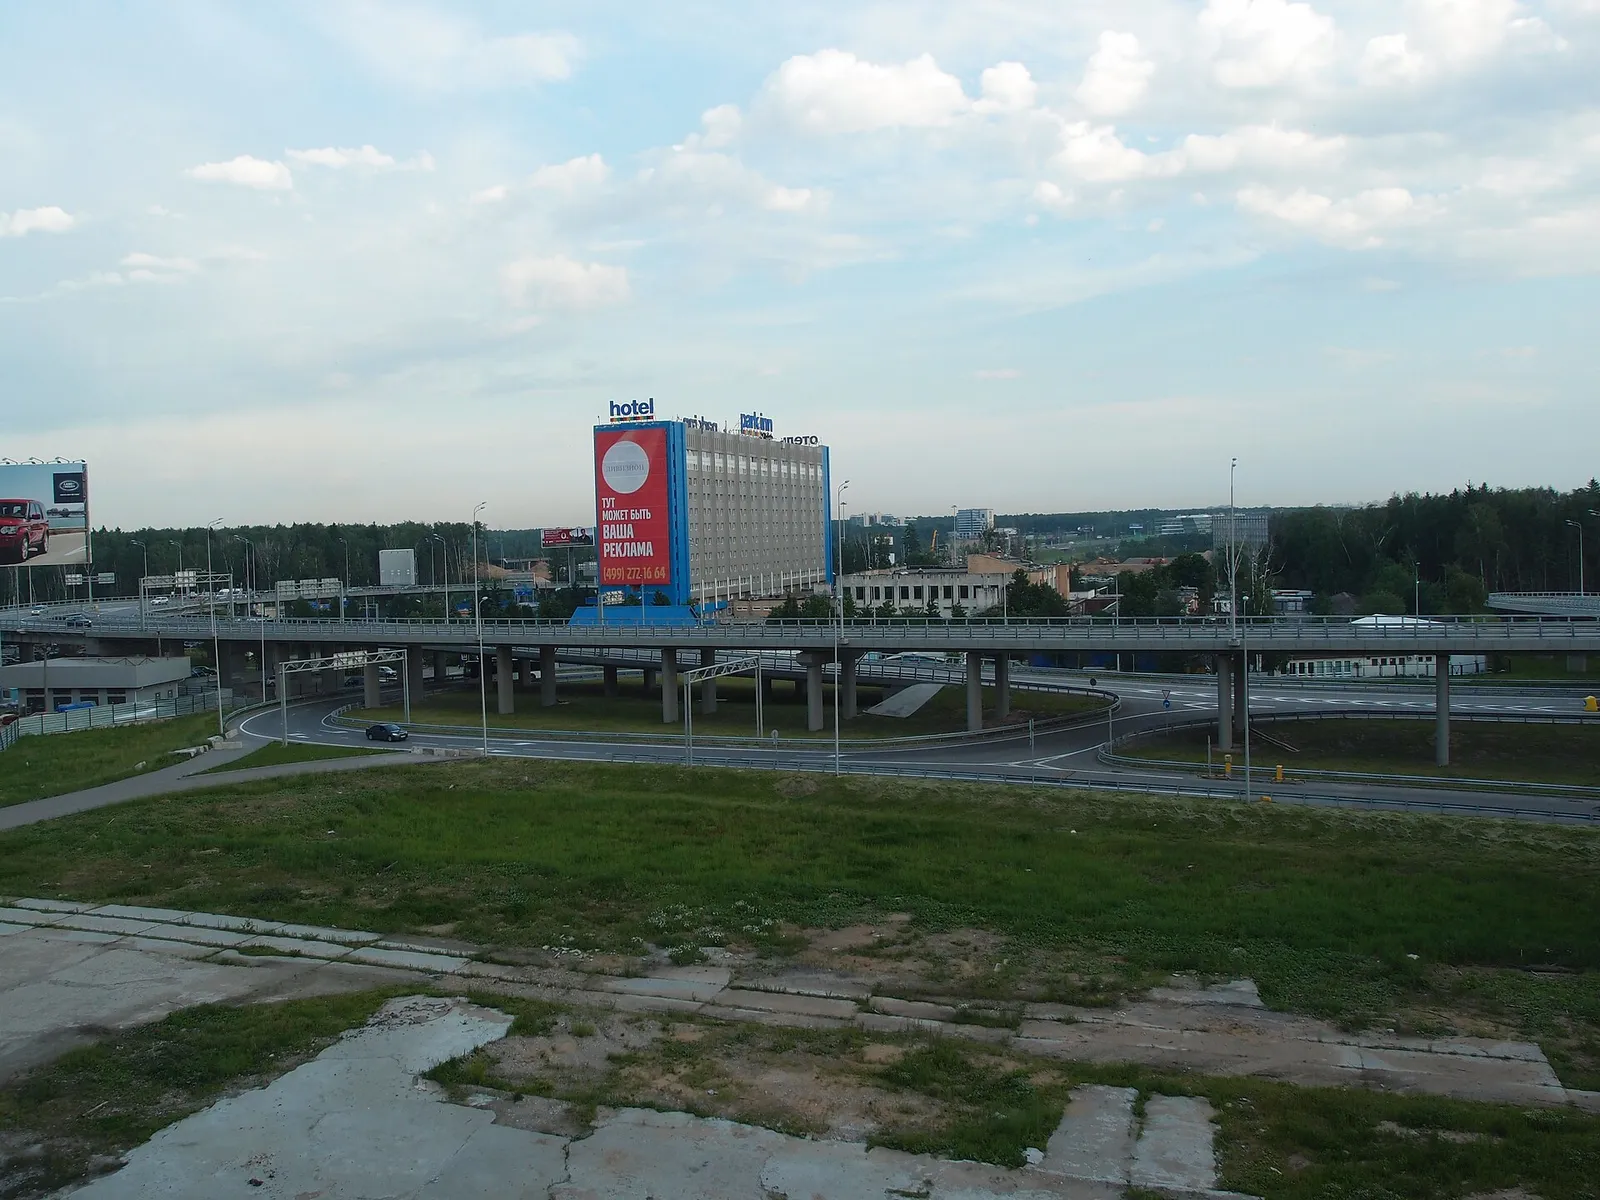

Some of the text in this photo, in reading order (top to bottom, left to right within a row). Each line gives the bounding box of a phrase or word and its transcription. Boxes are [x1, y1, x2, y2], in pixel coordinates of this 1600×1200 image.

[609, 397, 654, 417] hotel
[740, 411, 773, 434] park inn
[601, 497, 615, 508] ТУТ
[602, 508, 651, 521] МОЖЕТ БЫТЬ
[602, 523, 634, 539] ВАША
[603, 541, 654, 558] РЕКЛАМА
[603, 566, 625, 581] (499)
[654, 566, 666, 579] 64
